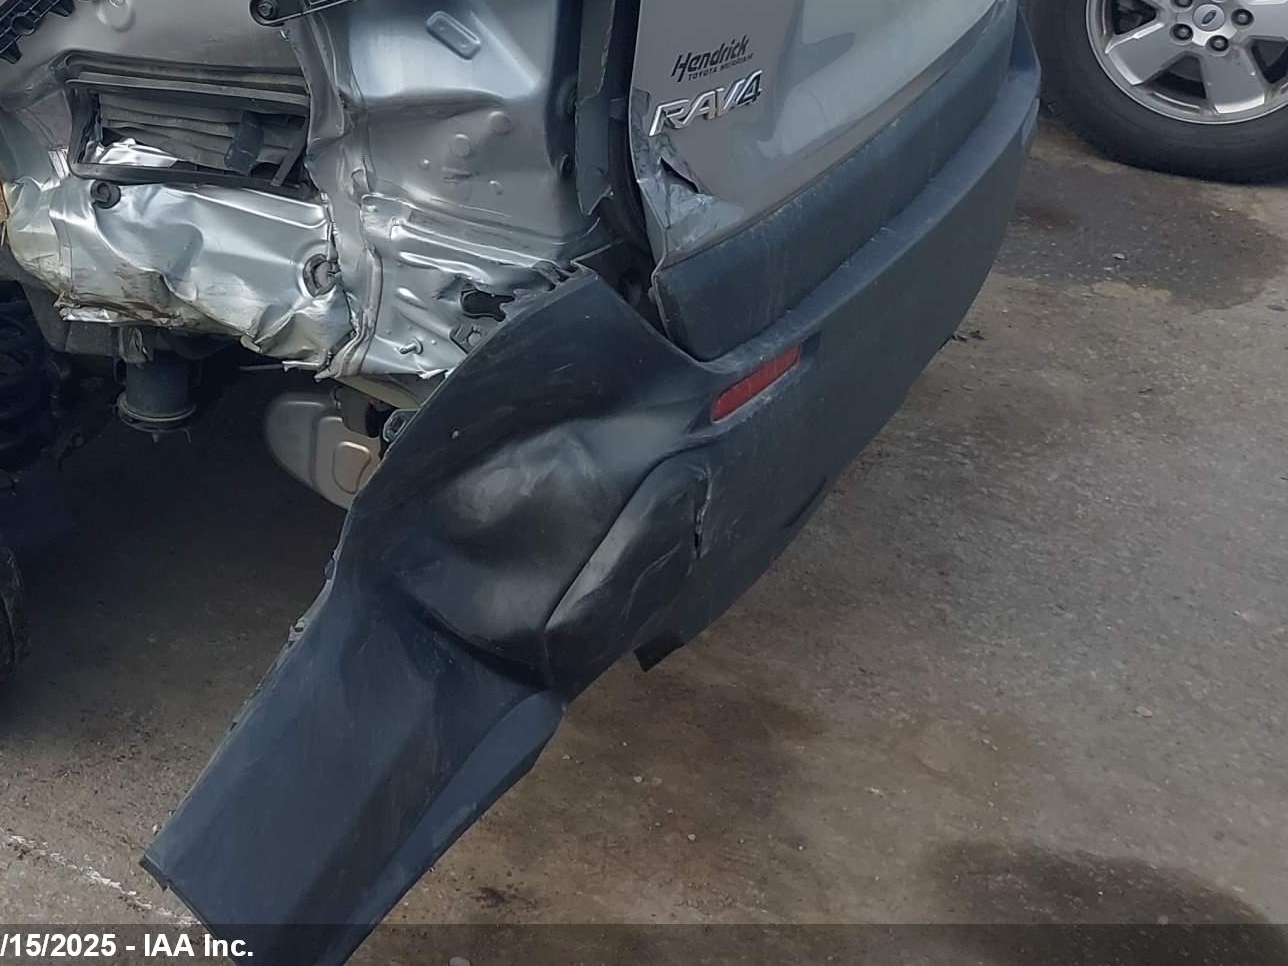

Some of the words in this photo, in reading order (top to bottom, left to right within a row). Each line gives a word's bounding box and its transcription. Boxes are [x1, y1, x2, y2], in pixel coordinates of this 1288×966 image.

[671, 35, 750, 82] Hendrick
[688, 66, 718, 81] TOYOTA
[649, 69, 763, 136] RAV4
